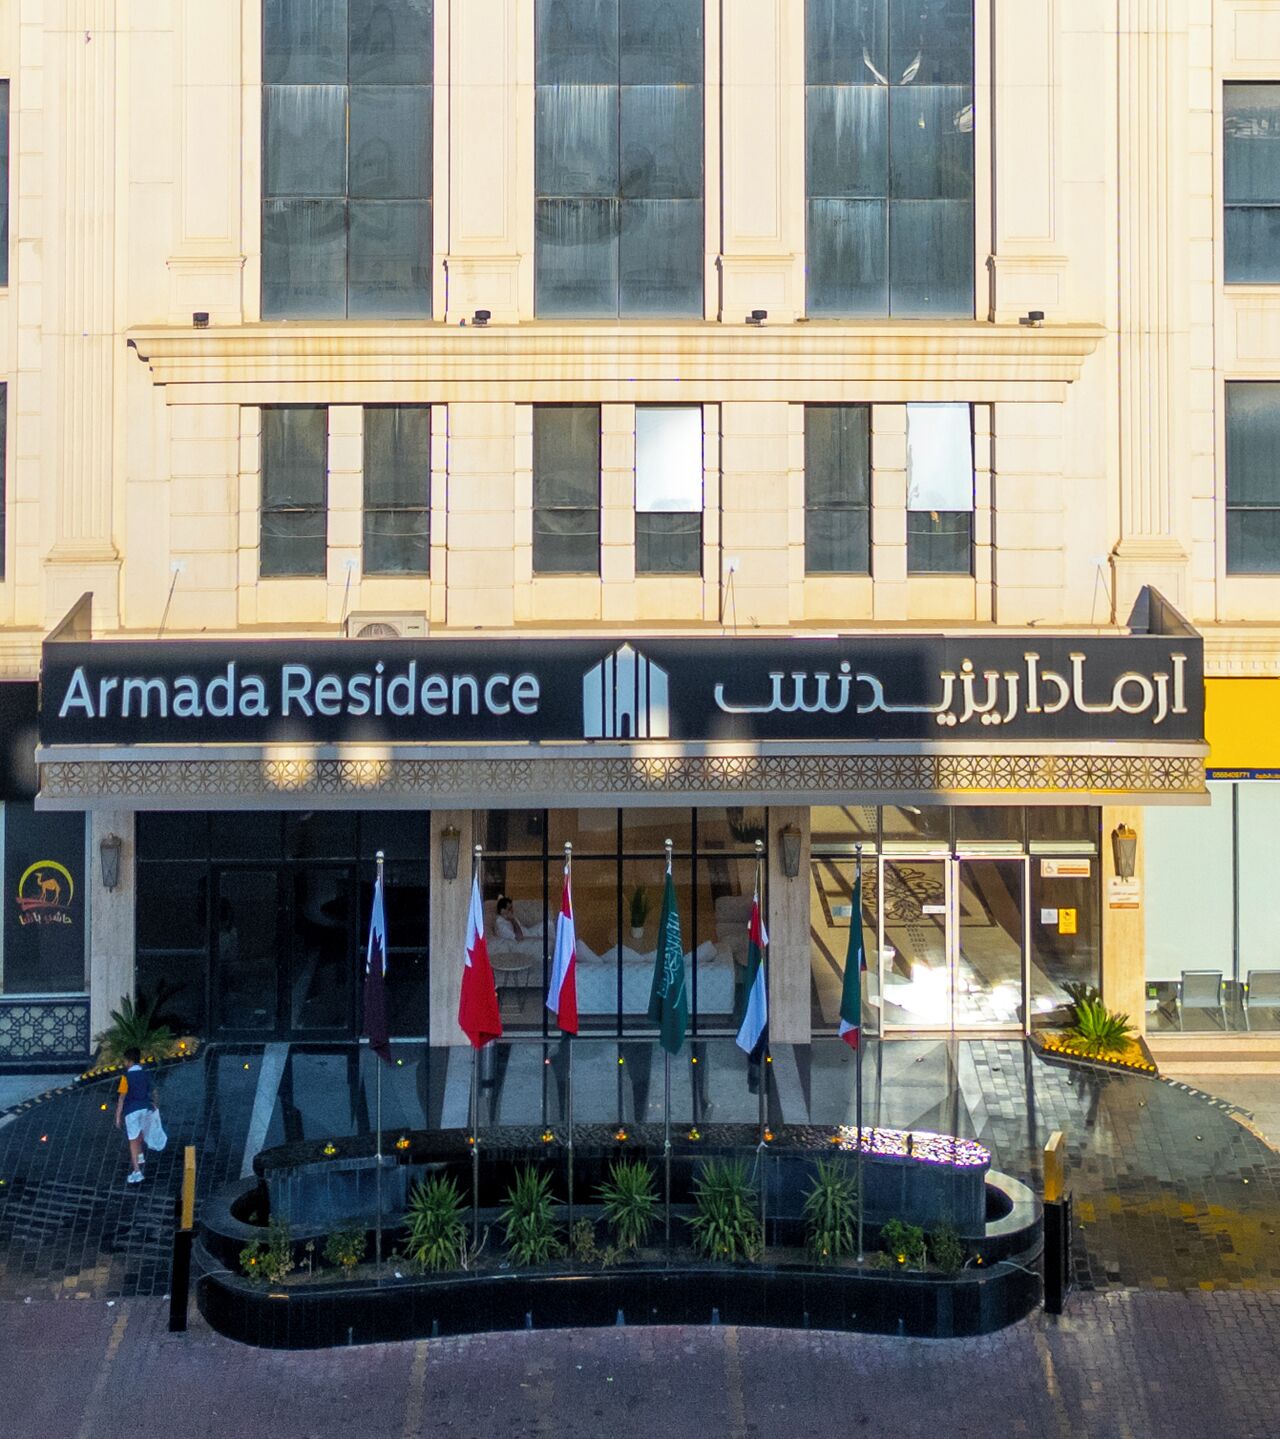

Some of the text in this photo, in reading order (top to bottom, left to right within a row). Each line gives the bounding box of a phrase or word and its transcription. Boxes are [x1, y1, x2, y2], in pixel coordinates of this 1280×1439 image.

[58, 659, 541, 718] Armada Residence
[714, 651, 1187, 727] ارمادا ريزيدنس
